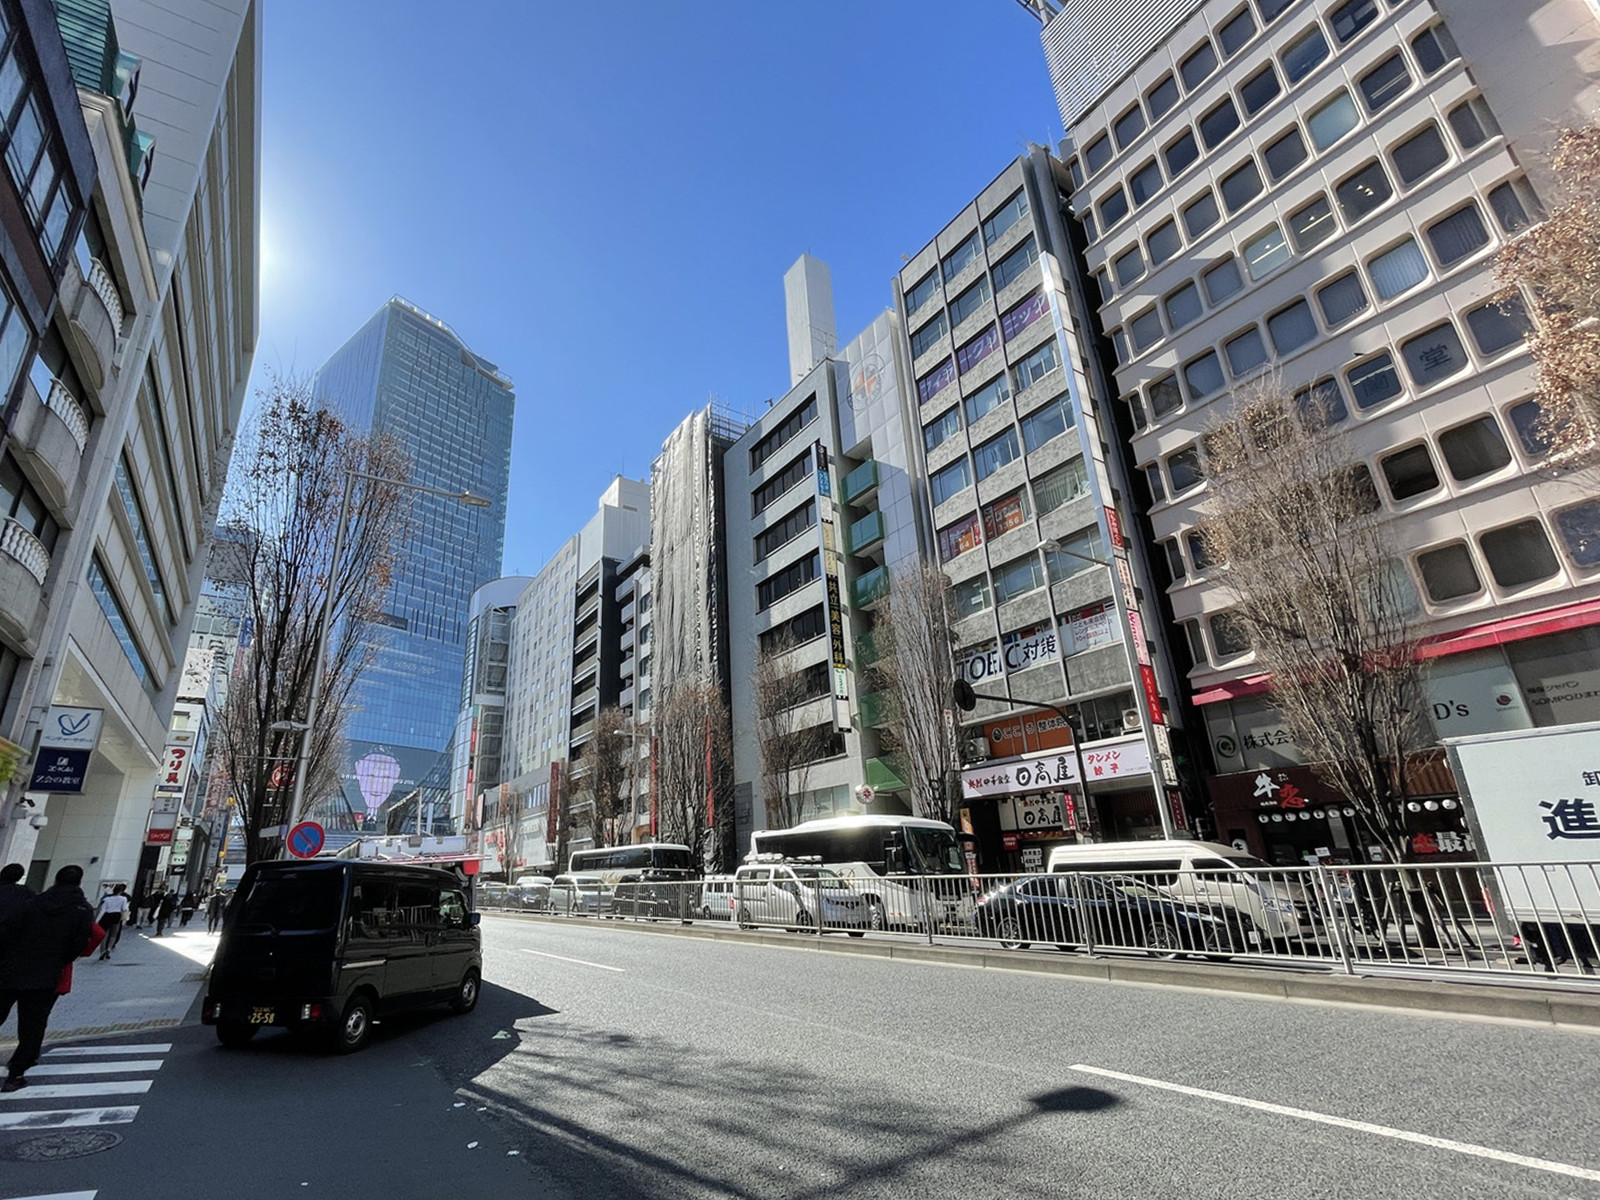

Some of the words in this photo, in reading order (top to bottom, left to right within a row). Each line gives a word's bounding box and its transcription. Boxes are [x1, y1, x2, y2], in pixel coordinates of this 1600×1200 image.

[1419, 344, 1452, 371] 堂
[828, 580, 843, 663] 共立美容外科
[1433, 700, 1470, 720] D's
[165, 748, 187, 784] つり具
[1087, 750, 1121, 764] タンメン
[1093, 763, 1119, 776] 餃子
[1016, 756, 1075, 787] 日高屋
[1538, 798, 1600, 840] 進
[250, 1012, 275, 1024] 25-58
